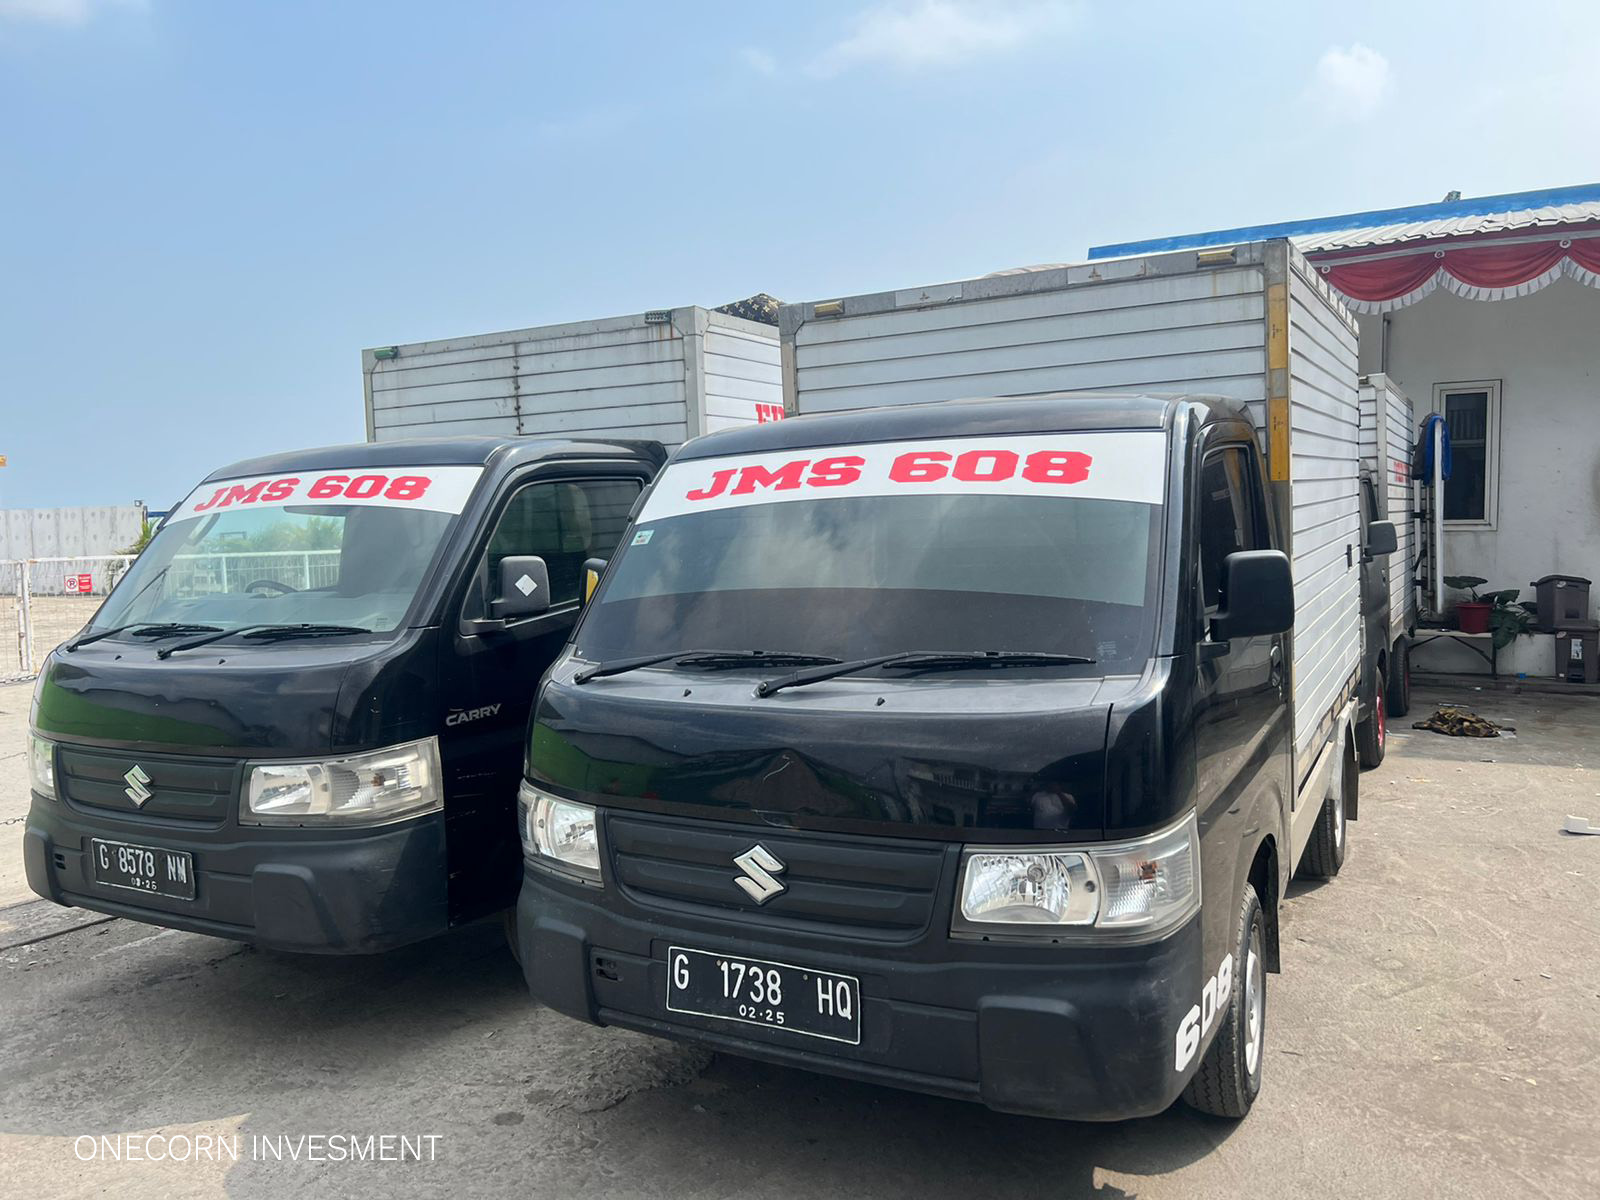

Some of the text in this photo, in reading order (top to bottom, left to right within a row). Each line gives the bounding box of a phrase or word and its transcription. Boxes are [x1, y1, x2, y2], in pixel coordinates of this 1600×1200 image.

[193, 474, 433, 512] JMS 608
[685, 449, 1093, 501] JMS 608
[445, 702, 503, 727] CARRY
[99, 844, 110, 870] G
[118, 847, 155, 878] 8578
[673, 953, 853, 1021] G 1738 HQ
[1174, 952, 1234, 1073] 608
